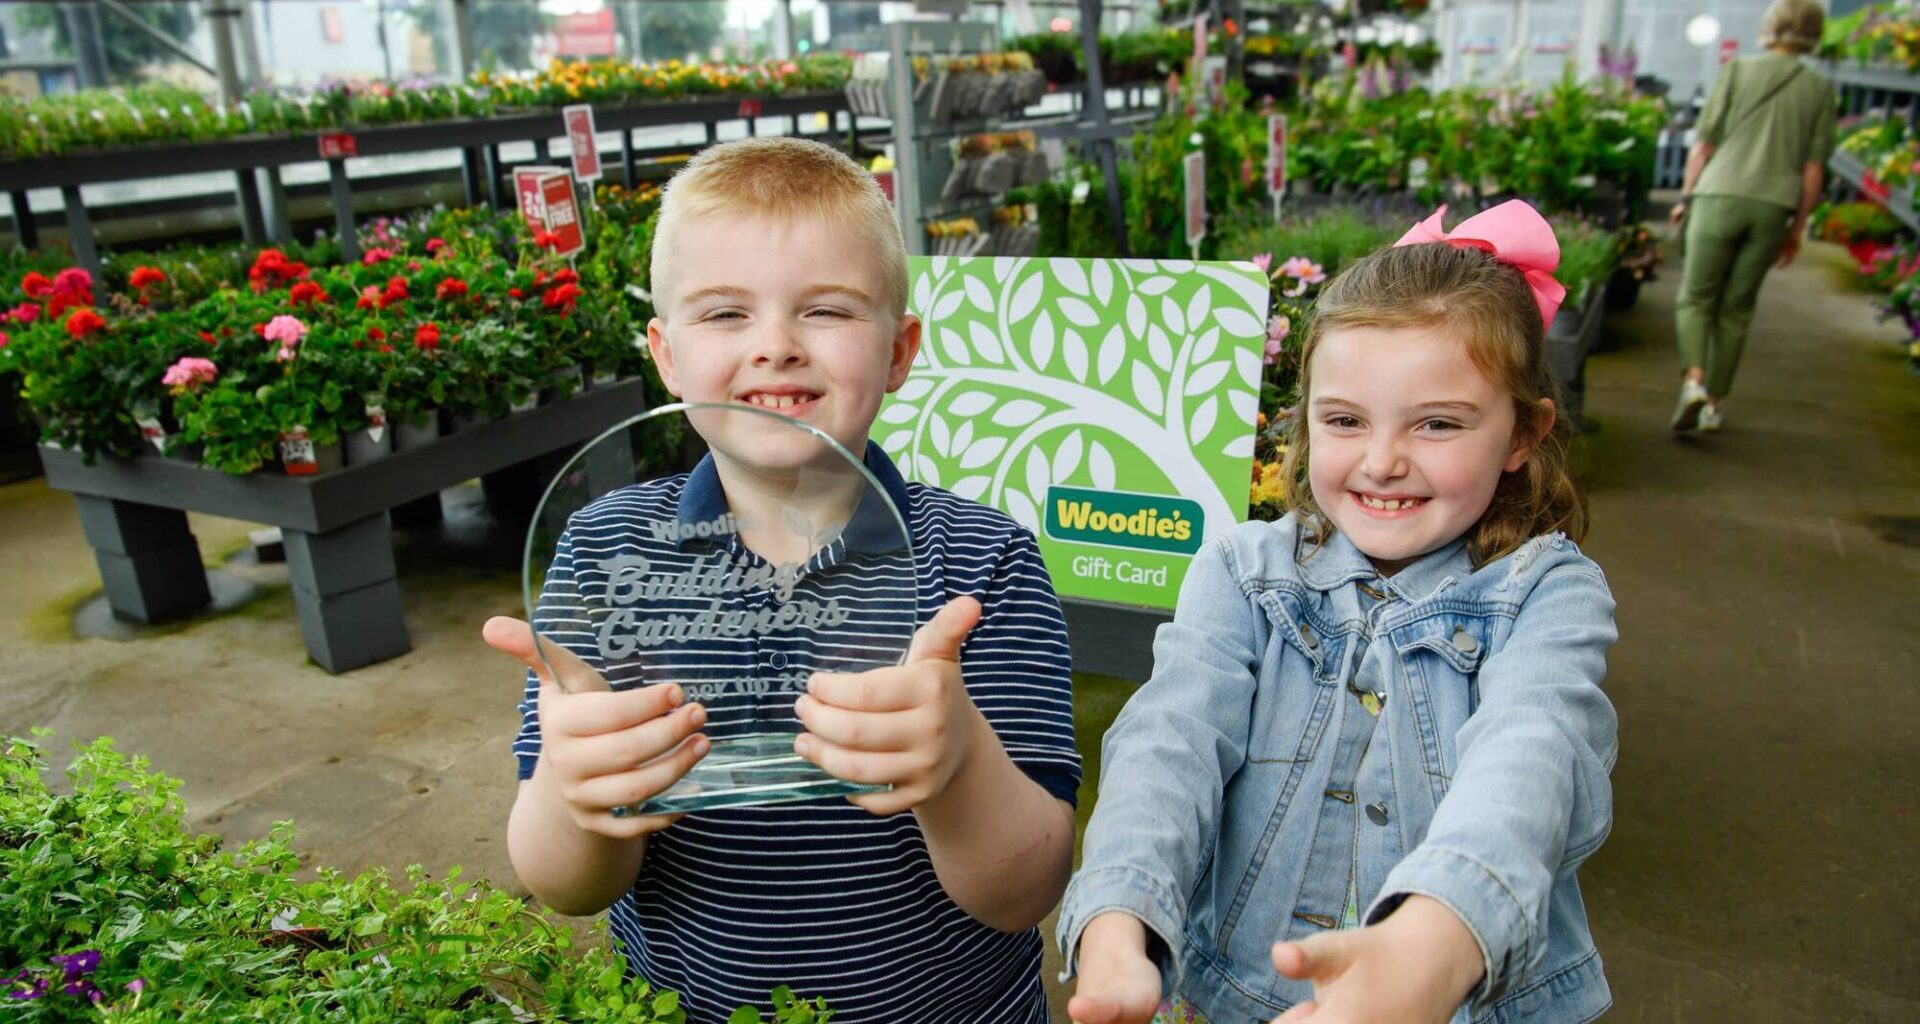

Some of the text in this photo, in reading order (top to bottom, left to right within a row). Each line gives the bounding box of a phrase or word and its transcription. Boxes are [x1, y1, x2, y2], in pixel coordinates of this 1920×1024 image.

[1057, 499, 1192, 541] Woodie's
[597, 551, 806, 607] Budding
[1072, 556, 1167, 587] Gift Card
[597, 599, 849, 660] Gardeners
